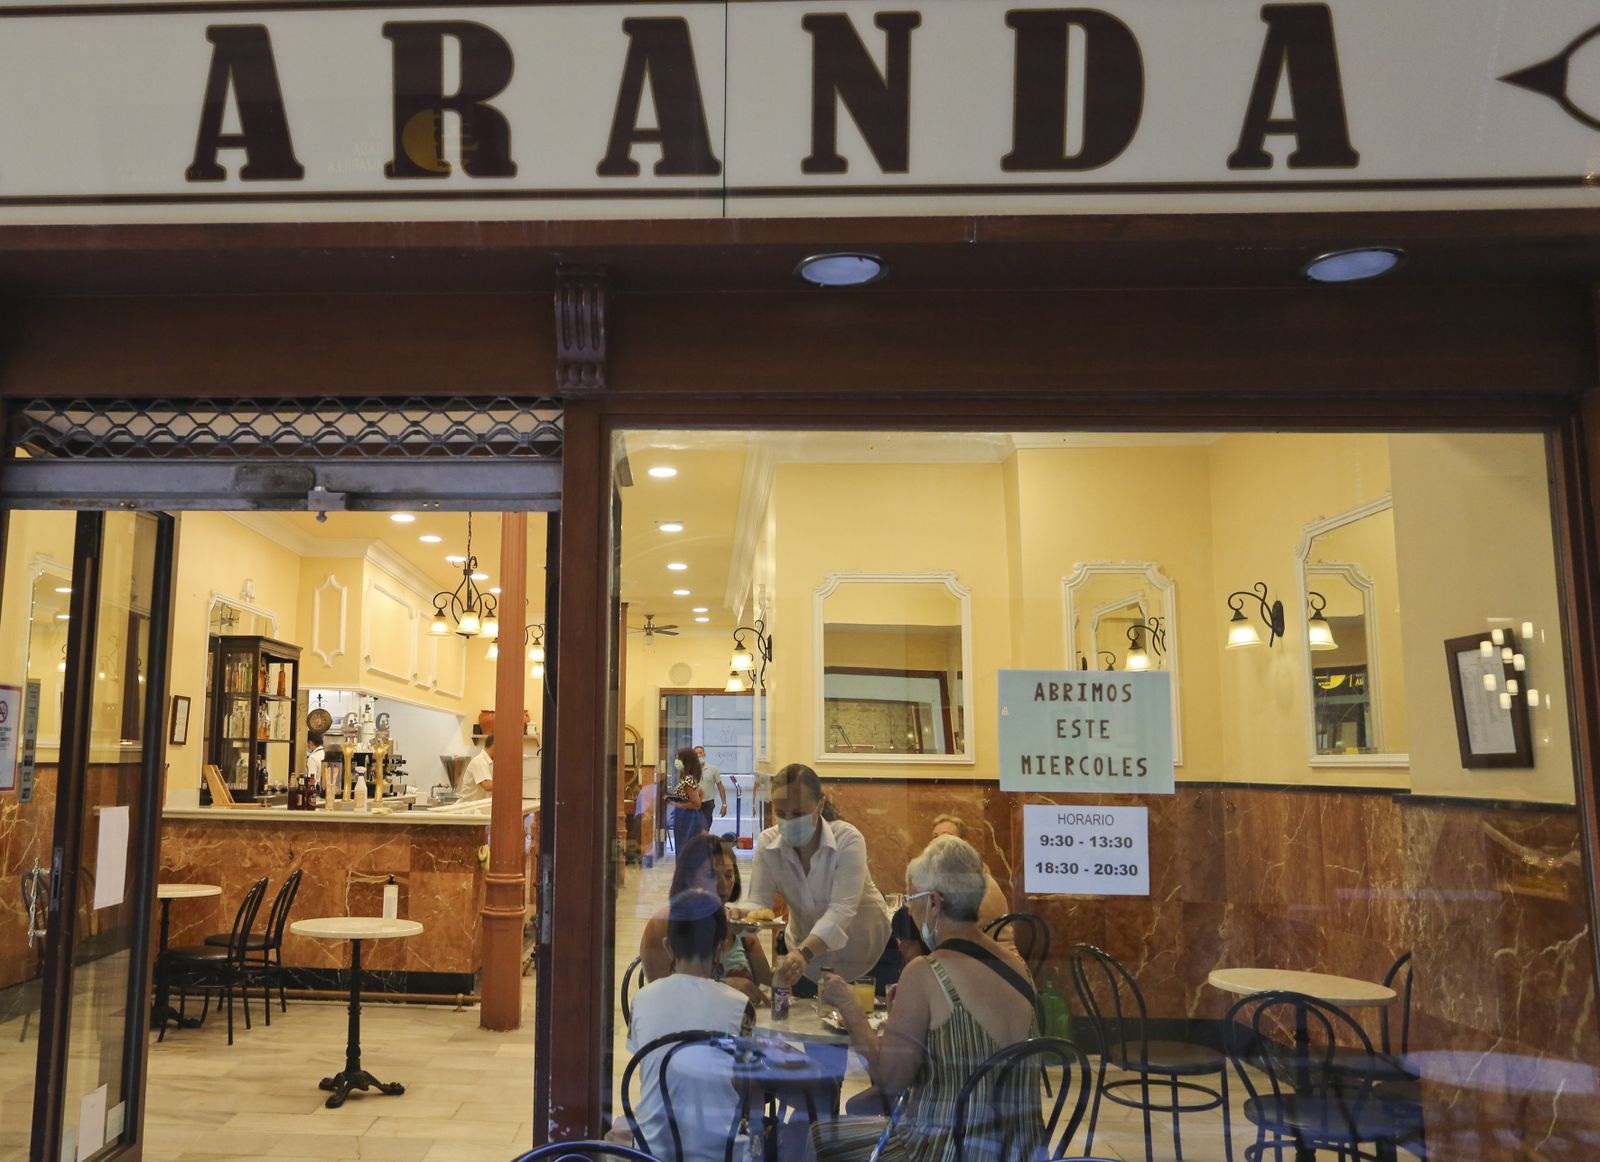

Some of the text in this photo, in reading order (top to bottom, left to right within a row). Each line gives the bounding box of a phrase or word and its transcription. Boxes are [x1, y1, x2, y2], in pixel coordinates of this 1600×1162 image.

[185, 3, 1359, 182] ARANDA
[1034, 682, 1132, 703] ABRIMOS
[1056, 719, 1110, 739] ESTE
[1021, 755, 1148, 777] MIERCOLES
[1058, 813, 1115, 826] HORARIO
[1040, 835, 1074, 848] 9:30
[1089, 836, 1133, 848] 13:30
[1035, 862, 1079, 875] 18:30
[1094, 864, 1138, 876] 20:30
